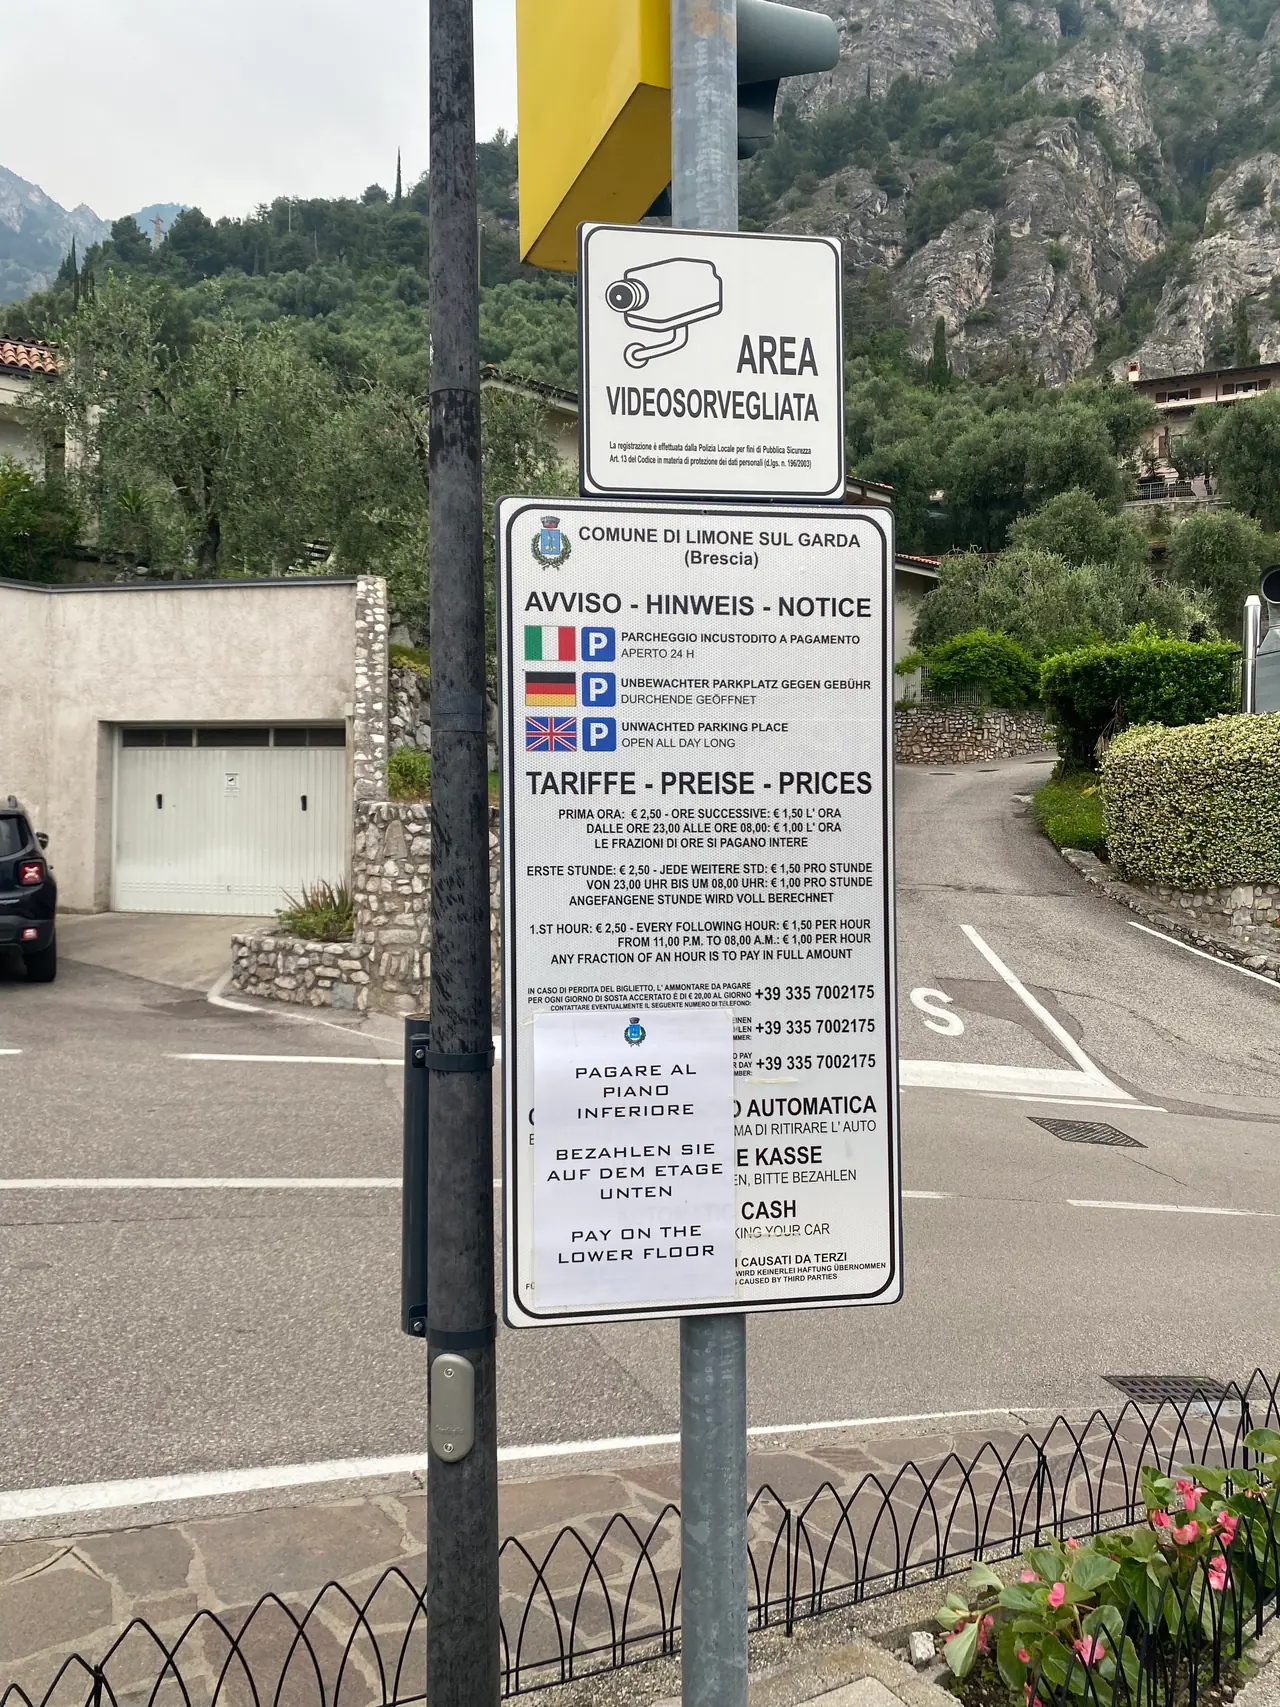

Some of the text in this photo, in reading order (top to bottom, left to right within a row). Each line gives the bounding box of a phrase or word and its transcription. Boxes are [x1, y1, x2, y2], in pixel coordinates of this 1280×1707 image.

[736, 334, 818, 376] AREA
[605, 386, 819, 421] VIDEOSORVEGLIATA
[609, 441, 811, 454] La registrazione è effettuata dalla Polizia Locale per fini di Pubblica Sicurezza
[578, 526, 860, 547] COMUNE DI LIMONE SUL GARDA
[684, 549, 758, 569] (Brescia)
[524, 591, 871, 617] AVVISO HINWEIS NOTICE
[589, 632, 860, 656] P PARCHEGGIO INCUSTODITO A PAGAMENTO
[620, 648, 694, 658] APERTO 24 H
[590, 678, 870, 702] P UNBEWACHTER PARKPLATZ GEGEN GEBÜHR
[620, 693, 756, 704] DURCHENDE GEÖFFNET
[590, 722, 788, 747] P UNWACHTED PARKING PLACE
[621, 737, 735, 747] OPEN ALL DAY LONG
[525, 770, 872, 795] TARIFFE PREISE PRICES
[558, 808, 594, 819] PRIMA
[596, 808, 624, 819] ORA:
[640, 808, 661, 820] 2,50
[671, 808, 694, 818] ORE
[697, 808, 769, 818] SUCCESSIVE:
[782, 808, 802, 819] 1,50
[818, 808, 841, 818] ORA
[594, 836, 807, 848] LE FRAZIONI DI ORE SI PAGANO INTERE
[568, 892, 833, 905] ANGEFANGENE STUNDE WIRD VOLL BERECHNET
[530, 918, 870, 934] 1.ST HOUR: 2,50 EVERY FOLLOWING HOUR: 1,50 PER HOUR
[550, 948, 852, 964] ANY FRACTION OF AN HOUR IS TO PAY IN FULL AMOUNT
[536, 986, 557, 994] CASO
[568, 985, 599, 993] PERDITA
[664, 983, 709, 992] AMMONTARE
[754, 984, 874, 1000] +39 335 7002175
[755, 1018, 875, 1034] +39 335 7002175
[756, 1053, 875, 1070] +39 335 7002175
[575, 1064, 696, 1078] PAGARE AL
[603, 1085, 668, 1097] PIANO
[577, 1104, 693, 1118] INFERIORE
[746, 1095, 876, 1117] AUTOMATICA
[755, 1123, 766, 1135] DI
[771, 1121, 827, 1134] RITIRARE
[842, 1119, 876, 1132] AUTO
[556, 1143, 714, 1160] BEZAHLEN SIE
[755, 1145, 822, 1165] KASSE
[547, 1163, 722, 1181] AUF DEM ETAGE
[754, 1169, 856, 1184] BITTE BEZAHLEN
[600, 1186, 671, 1199] UNTEN
[741, 1199, 796, 1220] CASH
[571, 1225, 701, 1242] PAY ON THE
[765, 1222, 829, 1237] YOUR CAR
[558, 1245, 713, 1263] LOWER FLOOR
[741, 1252, 846, 1266] CAUSATI DA TERZI
[756, 1267, 795, 1275] KEINERLEI
[797, 1265, 832, 1276] HAFTUNG
[832, 1262, 885, 1272] ÜBERNOMMEN
